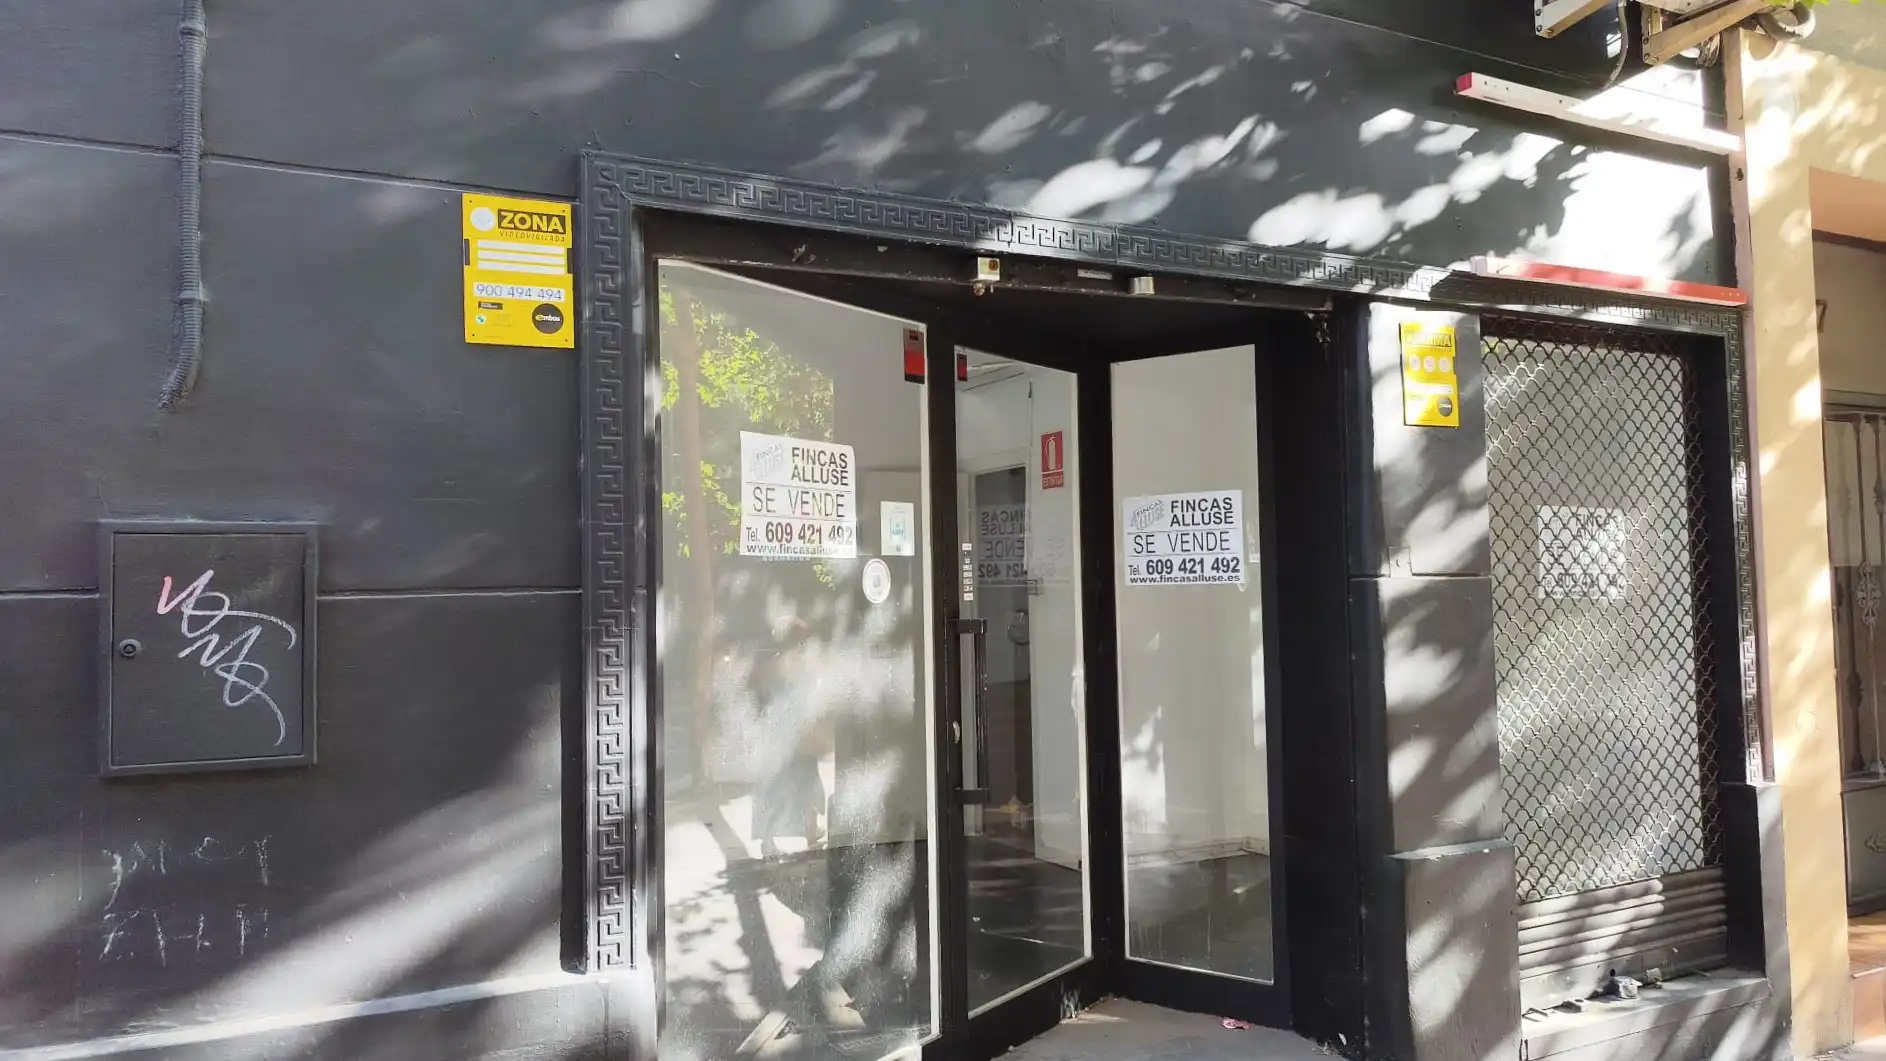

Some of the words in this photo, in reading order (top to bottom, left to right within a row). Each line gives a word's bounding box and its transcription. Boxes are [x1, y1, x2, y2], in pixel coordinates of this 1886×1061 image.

[501, 211, 564, 233] ZONA
[476, 284, 502, 296] 900
[507, 286, 532, 298] 494
[537, 288, 562, 300] 494
[791, 446, 848, 470] FINCAS
[790, 464, 849, 486] ALLUSE
[752, 486, 776, 513] SE
[788, 489, 845, 518] VENDE
[1171, 497, 1233, 513] FINCAS
[1169, 510, 1234, 528] ALLUSE
[745, 526, 761, 542] Tel.
[765, 521, 793, 543] 609
[797, 523, 823, 545] 421
[827, 525, 853, 546] 492
[1133, 534, 1156, 554] SE
[1167, 531, 1230, 553] VENDE
[1128, 564, 1141, 576] Tel.
[1146, 558, 1173, 576] 609
[1178, 557, 1204, 575] 421
[1210, 556, 1240, 574] 492
[1129, 574, 1240, 584] www.fincasalluse.es
